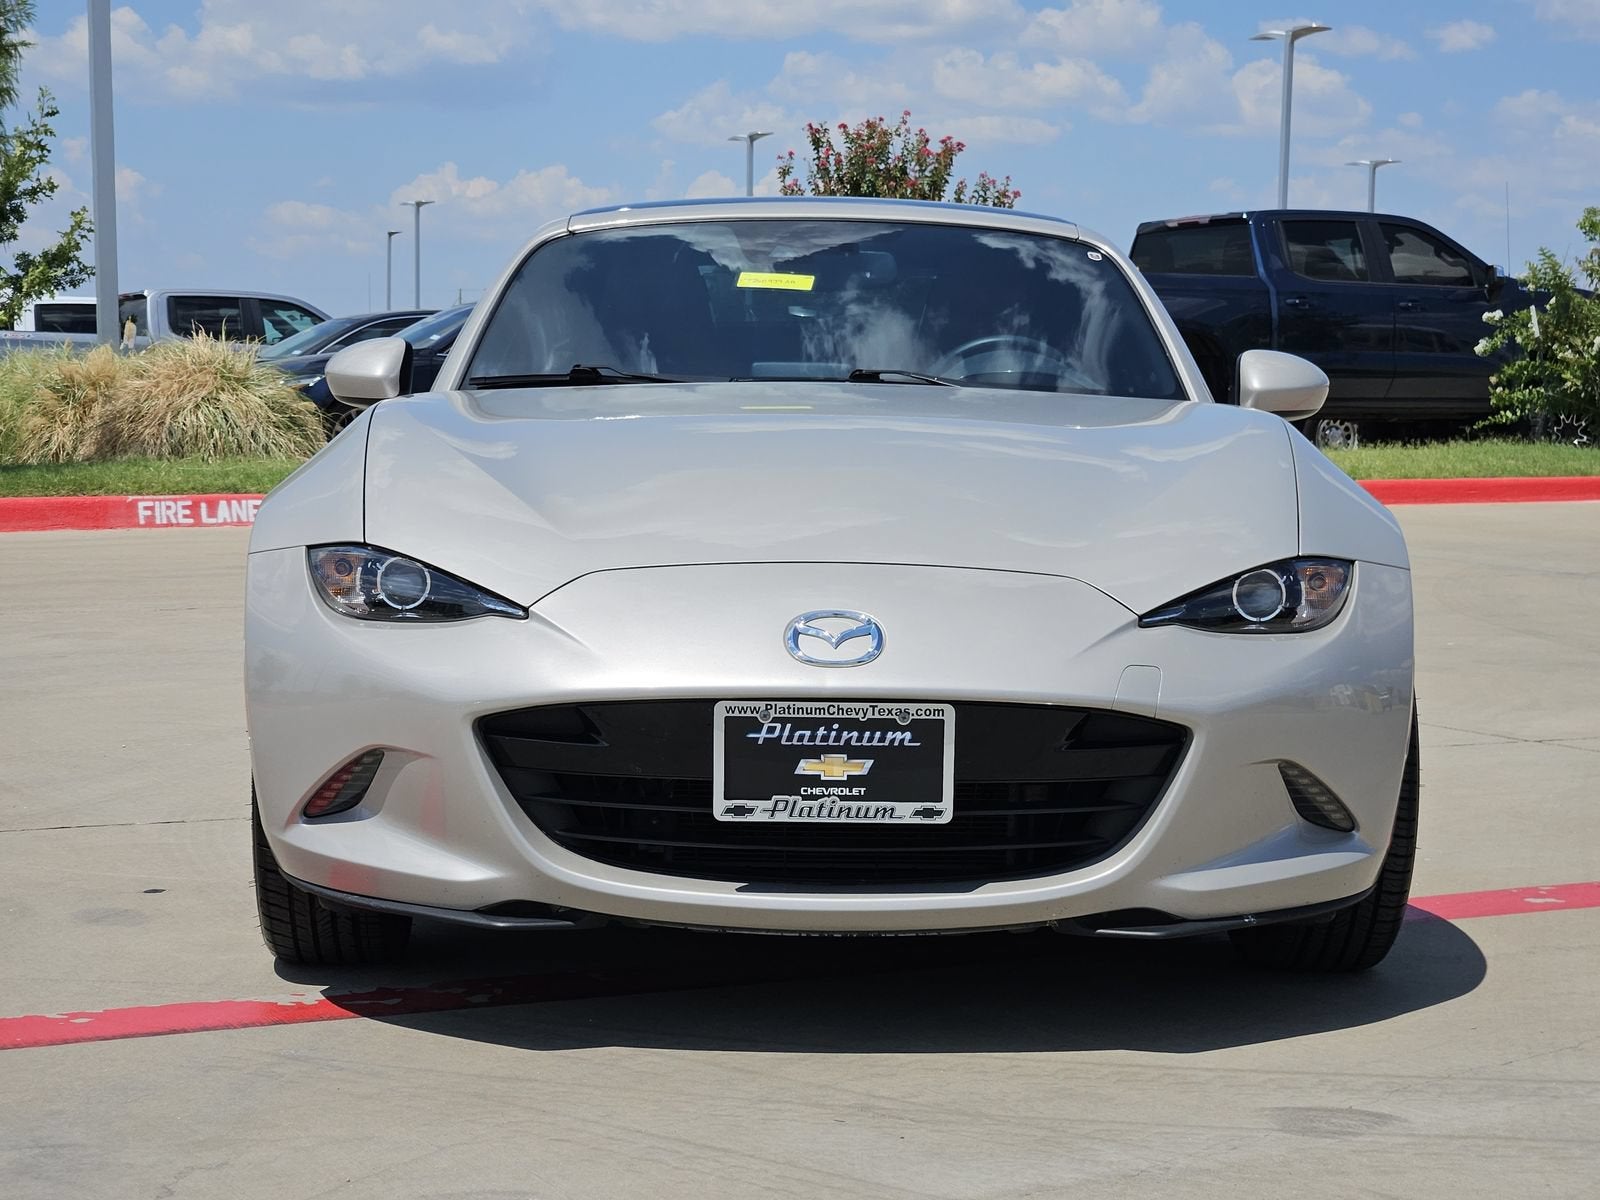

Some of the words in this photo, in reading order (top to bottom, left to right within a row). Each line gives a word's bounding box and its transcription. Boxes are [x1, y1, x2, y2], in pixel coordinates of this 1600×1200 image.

[138, 501, 195, 524] FIRE
[200, 499, 262, 523] LANE
[725, 703, 945, 719] wwwPlatinumChevyTexas.com
[746, 723, 921, 746] Platinum
[800, 787, 867, 796] CHEVROLET
[760, 799, 905, 819] Platinum
